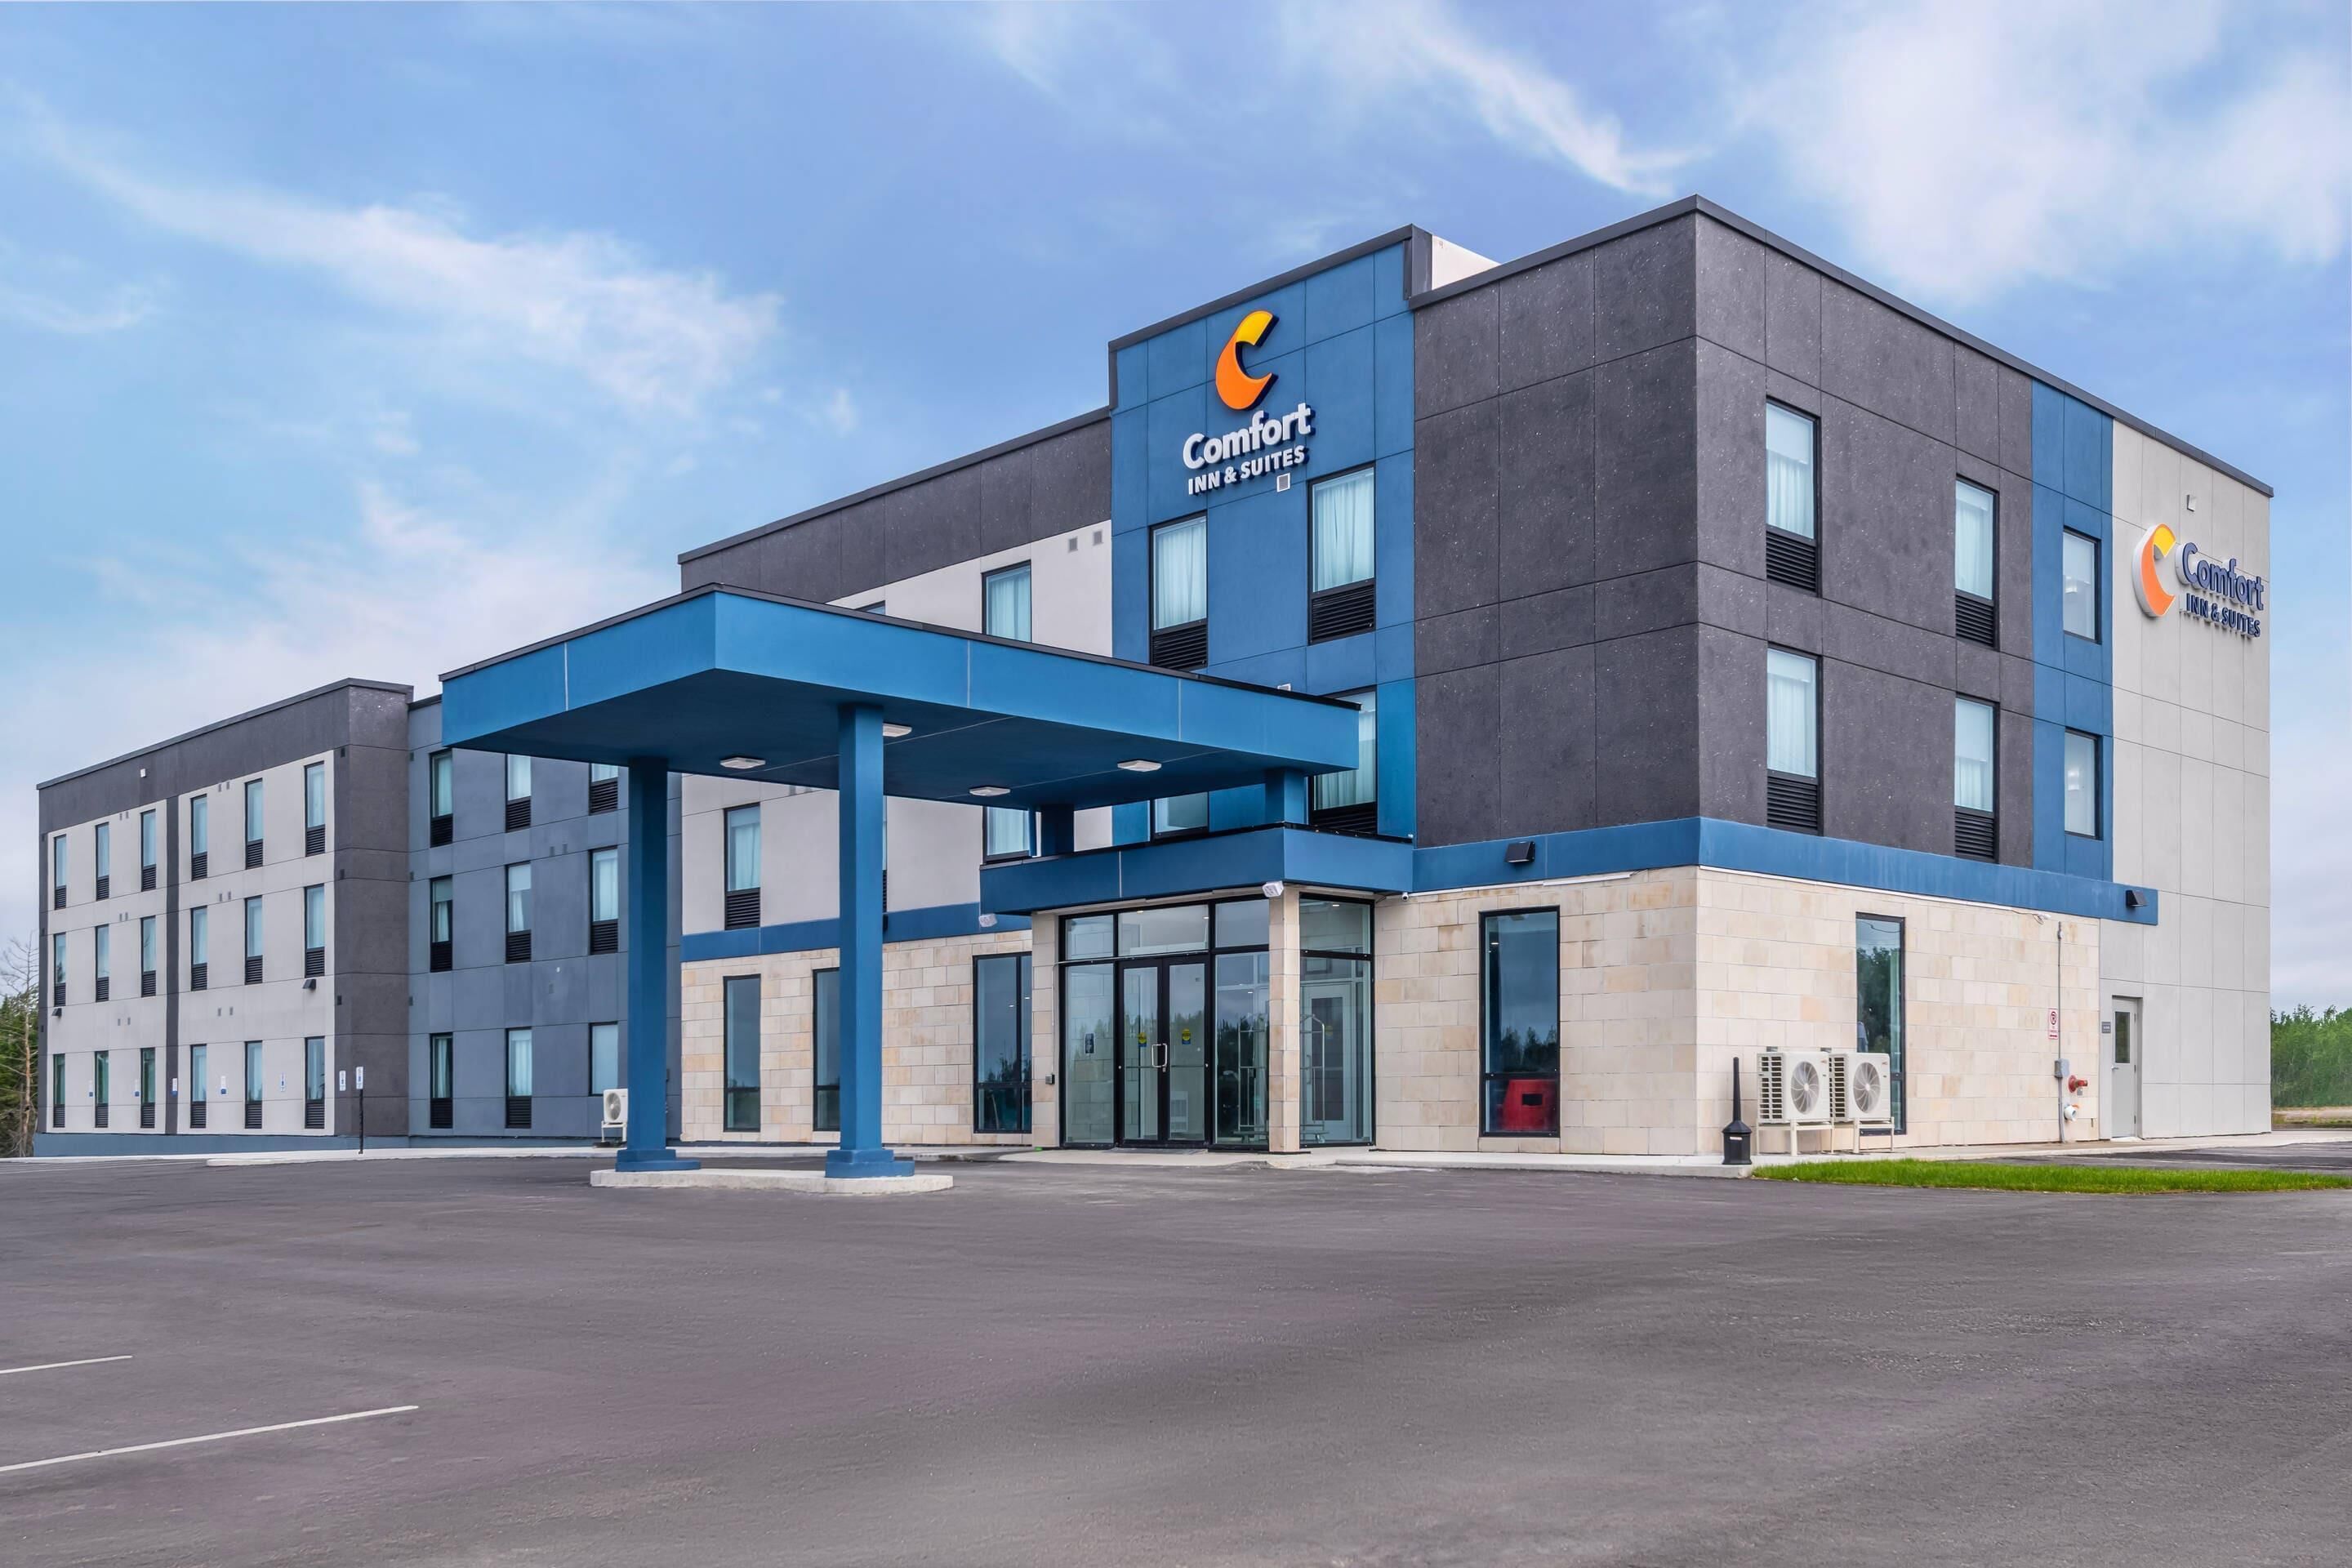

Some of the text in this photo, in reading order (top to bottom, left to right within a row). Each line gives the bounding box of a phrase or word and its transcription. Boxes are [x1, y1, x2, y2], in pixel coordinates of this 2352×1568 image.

[1183, 403, 1312, 470] Comfort
[1188, 445, 1306, 495] INN & SUITES
[2181, 541, 2265, 611] Comfort
[2185, 592, 2261, 637] INN & SUITES
